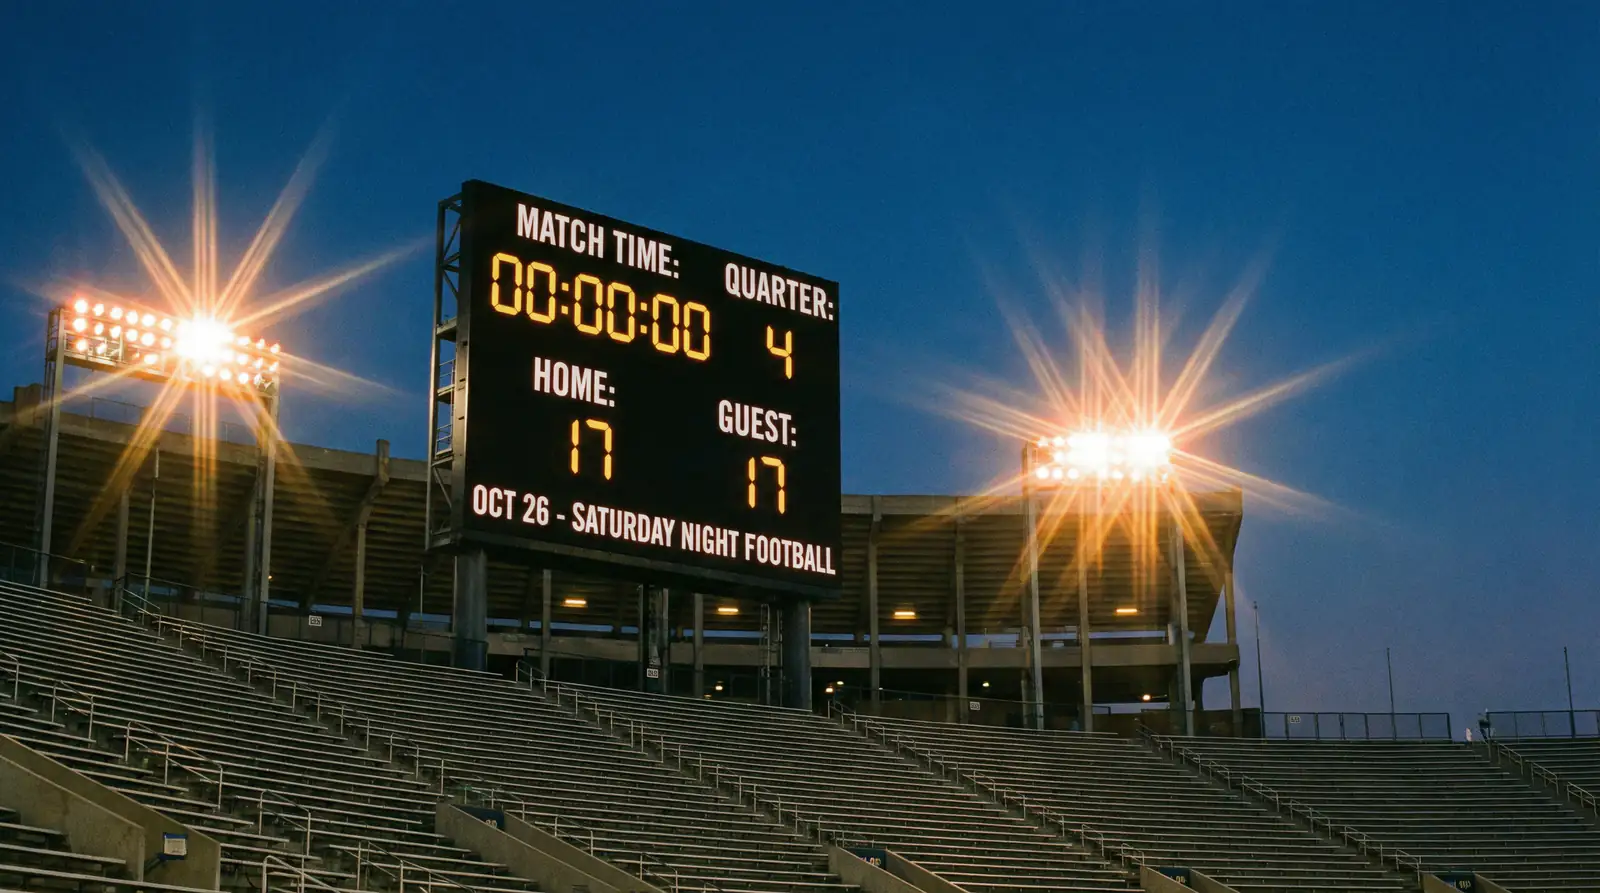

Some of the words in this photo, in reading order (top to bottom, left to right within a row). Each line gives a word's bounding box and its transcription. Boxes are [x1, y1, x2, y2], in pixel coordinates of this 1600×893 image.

[517, 203, 604, 259] MATCH
[612, 229, 680, 279] TIME:
[490, 252, 711, 362] 00:00:00
[725, 262, 834, 321] QUARTER:
[533, 356, 615, 408] HOME:
[766, 325, 793, 380] 4
[570, 418, 613, 481] 17
[718, 399, 797, 447] GUEST:
[747, 455, 786, 515] 17
[472, 483, 517, 520] OCT
[522, 492, 550, 526] 26
[556, 513, 566, 521] -
[571, 501, 676, 548] SATURDAY
[681, 521, 740, 559] NIGHT
[744, 532, 836, 576] FOOTBALL
